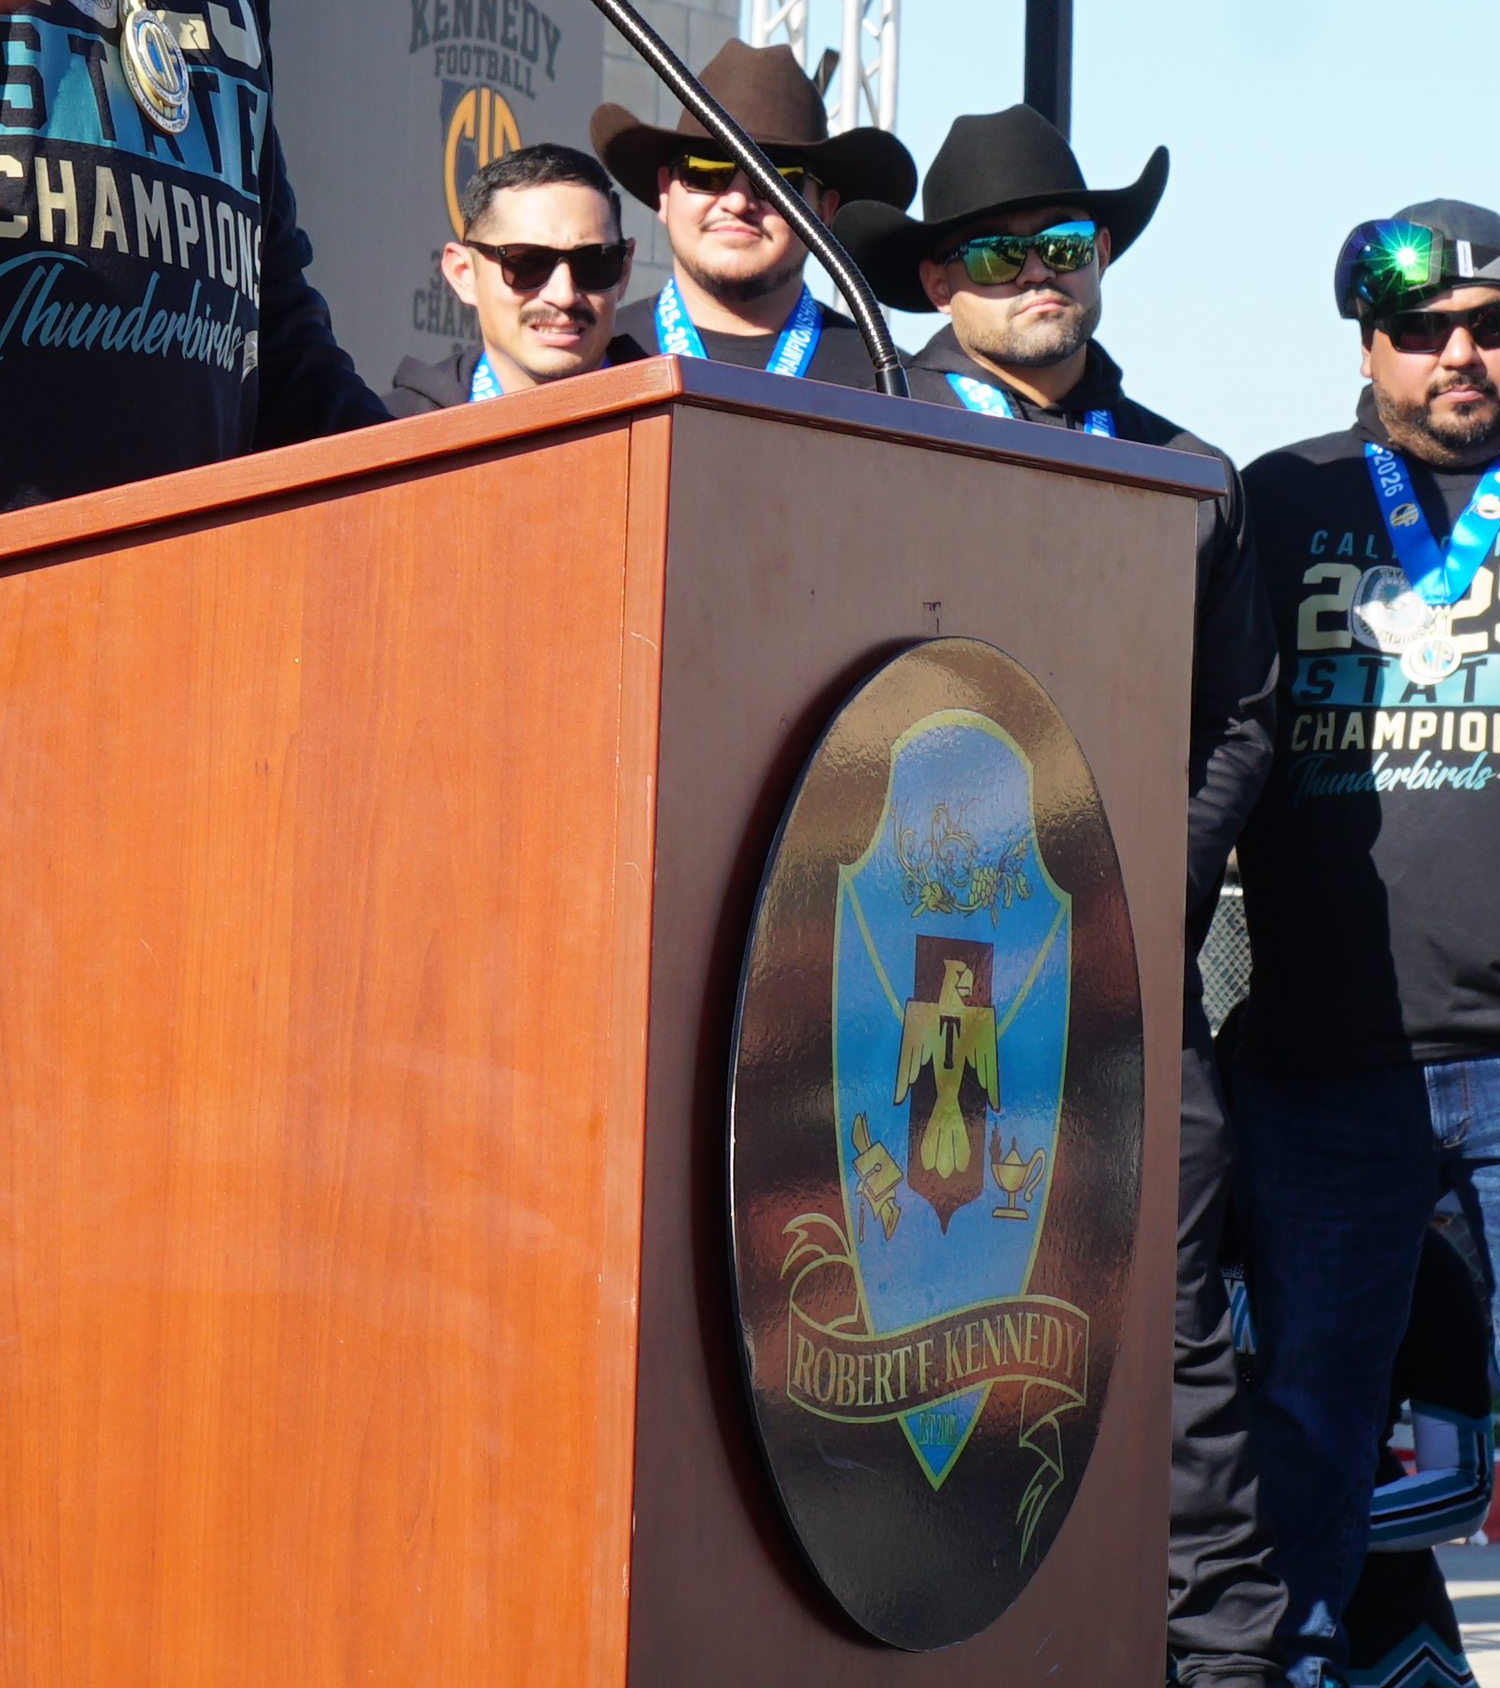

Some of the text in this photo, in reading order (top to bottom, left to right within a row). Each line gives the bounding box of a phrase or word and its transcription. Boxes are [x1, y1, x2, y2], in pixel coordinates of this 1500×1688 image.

[433, 43, 537, 101] FOOTBALL
[1287, 749, 1497, 804] Thunderbirds
[939, 1014, 963, 1071] T
[790, 1311, 1083, 1407] ROBERT F. KENNEDY
